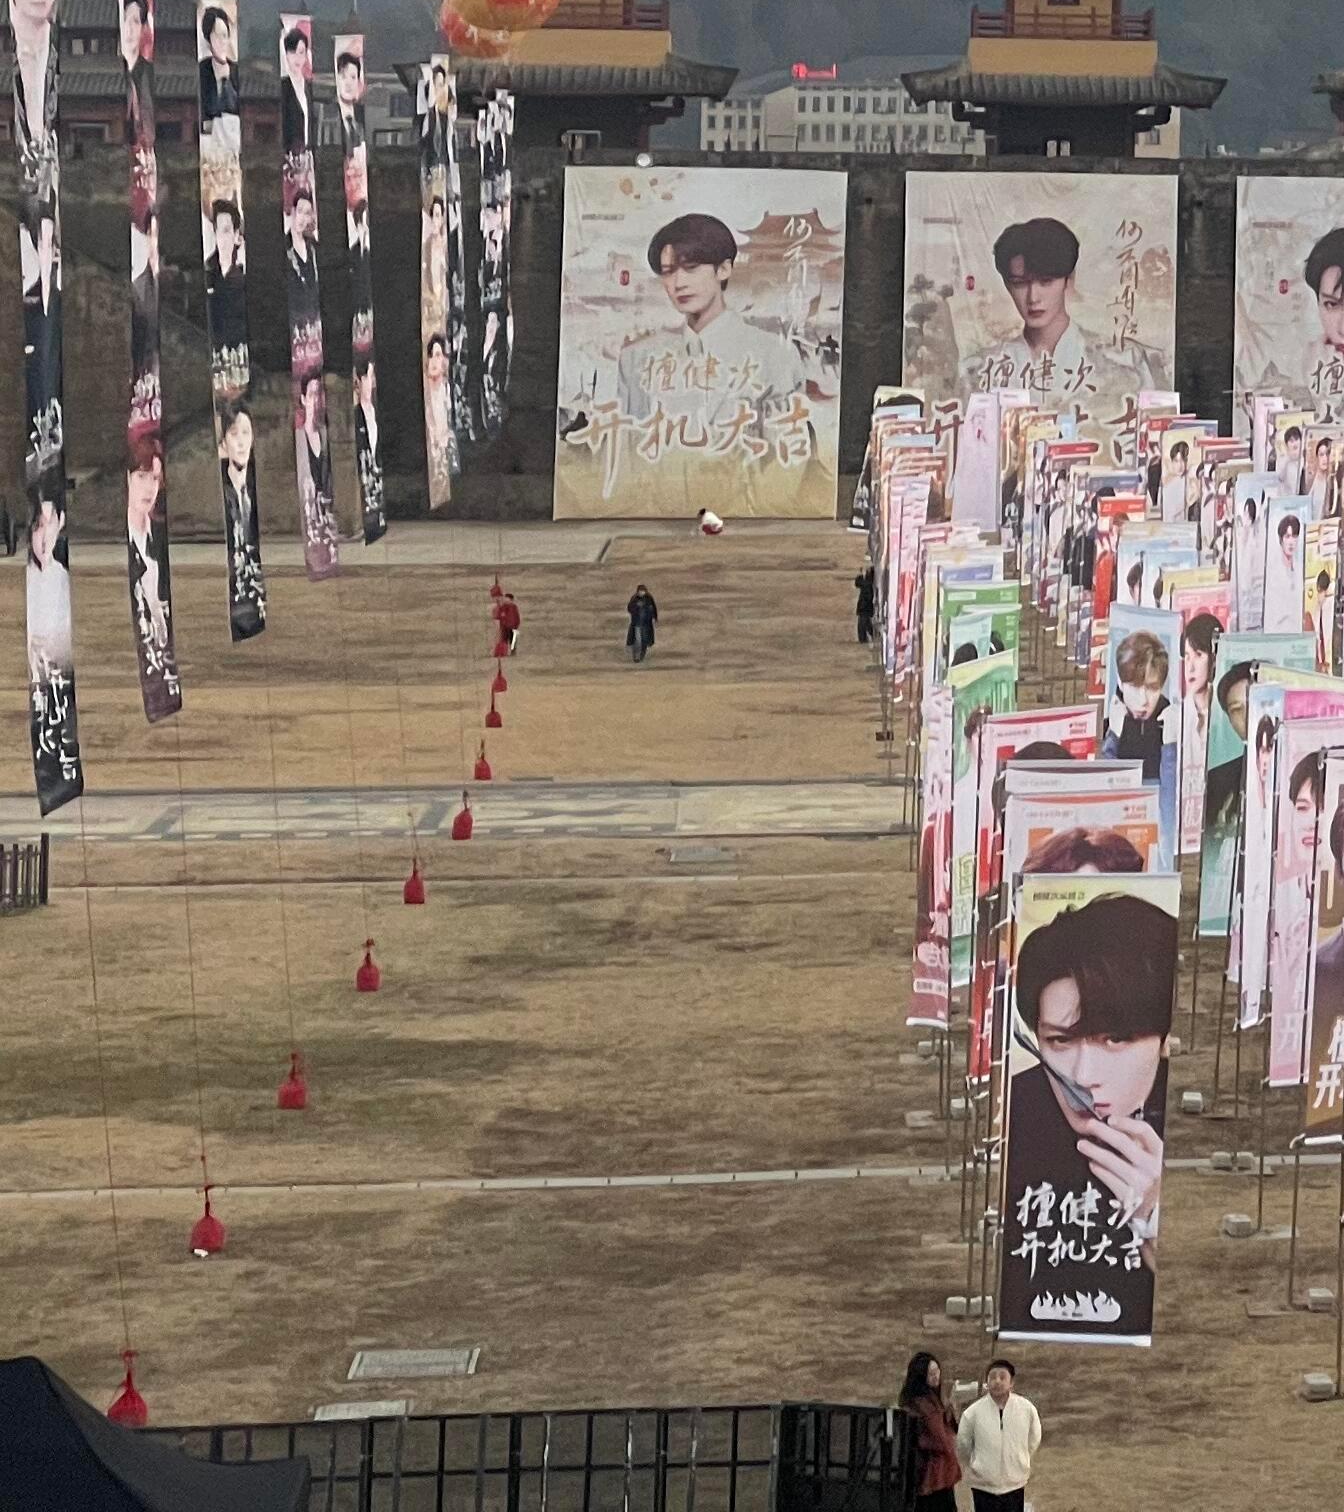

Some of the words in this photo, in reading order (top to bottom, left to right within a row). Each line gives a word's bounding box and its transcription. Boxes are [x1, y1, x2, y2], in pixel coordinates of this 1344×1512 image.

[639, 352, 766, 392] 檀健次
[978, 351, 1097, 401] 檀健次
[566, 393, 812, 499] 开机大吉
[1016, 1180, 1145, 1241] 檀健次
[1010, 1230, 1144, 1282] 开机大吉
